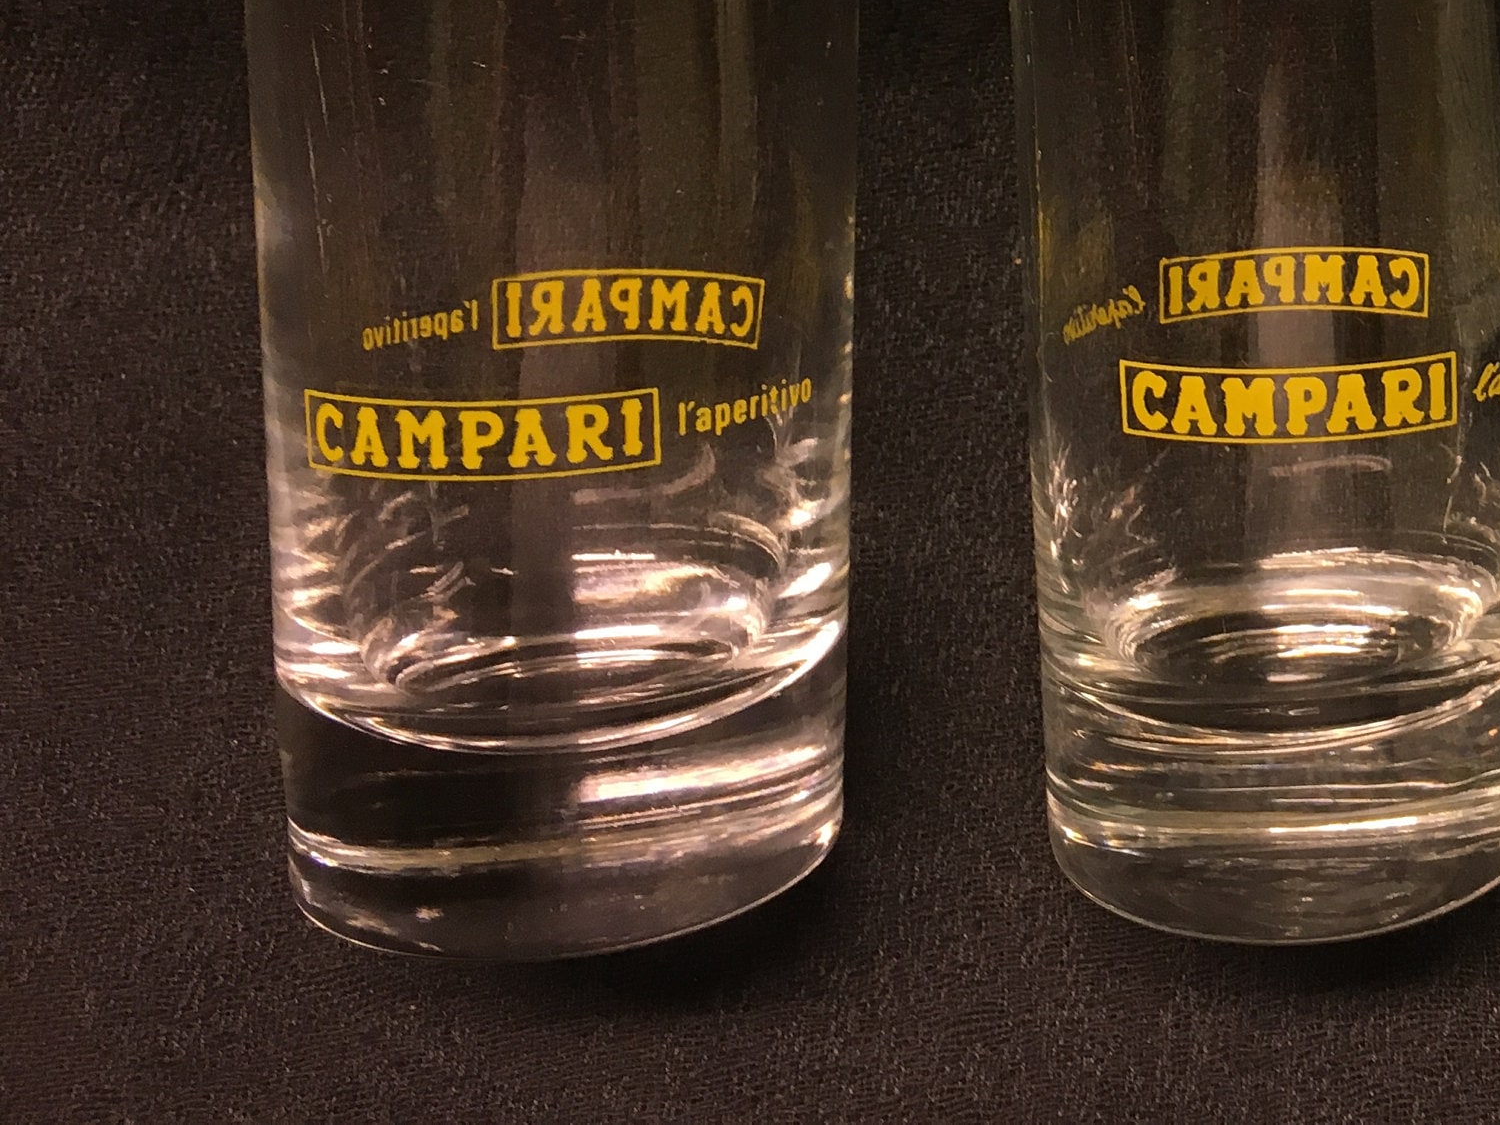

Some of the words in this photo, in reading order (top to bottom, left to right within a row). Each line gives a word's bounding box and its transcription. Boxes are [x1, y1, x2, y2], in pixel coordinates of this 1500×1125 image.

[314, 397, 646, 471] CAMPARI
[677, 376, 813, 436] l'aperitivo
[1131, 362, 1447, 437] CAMPARI
